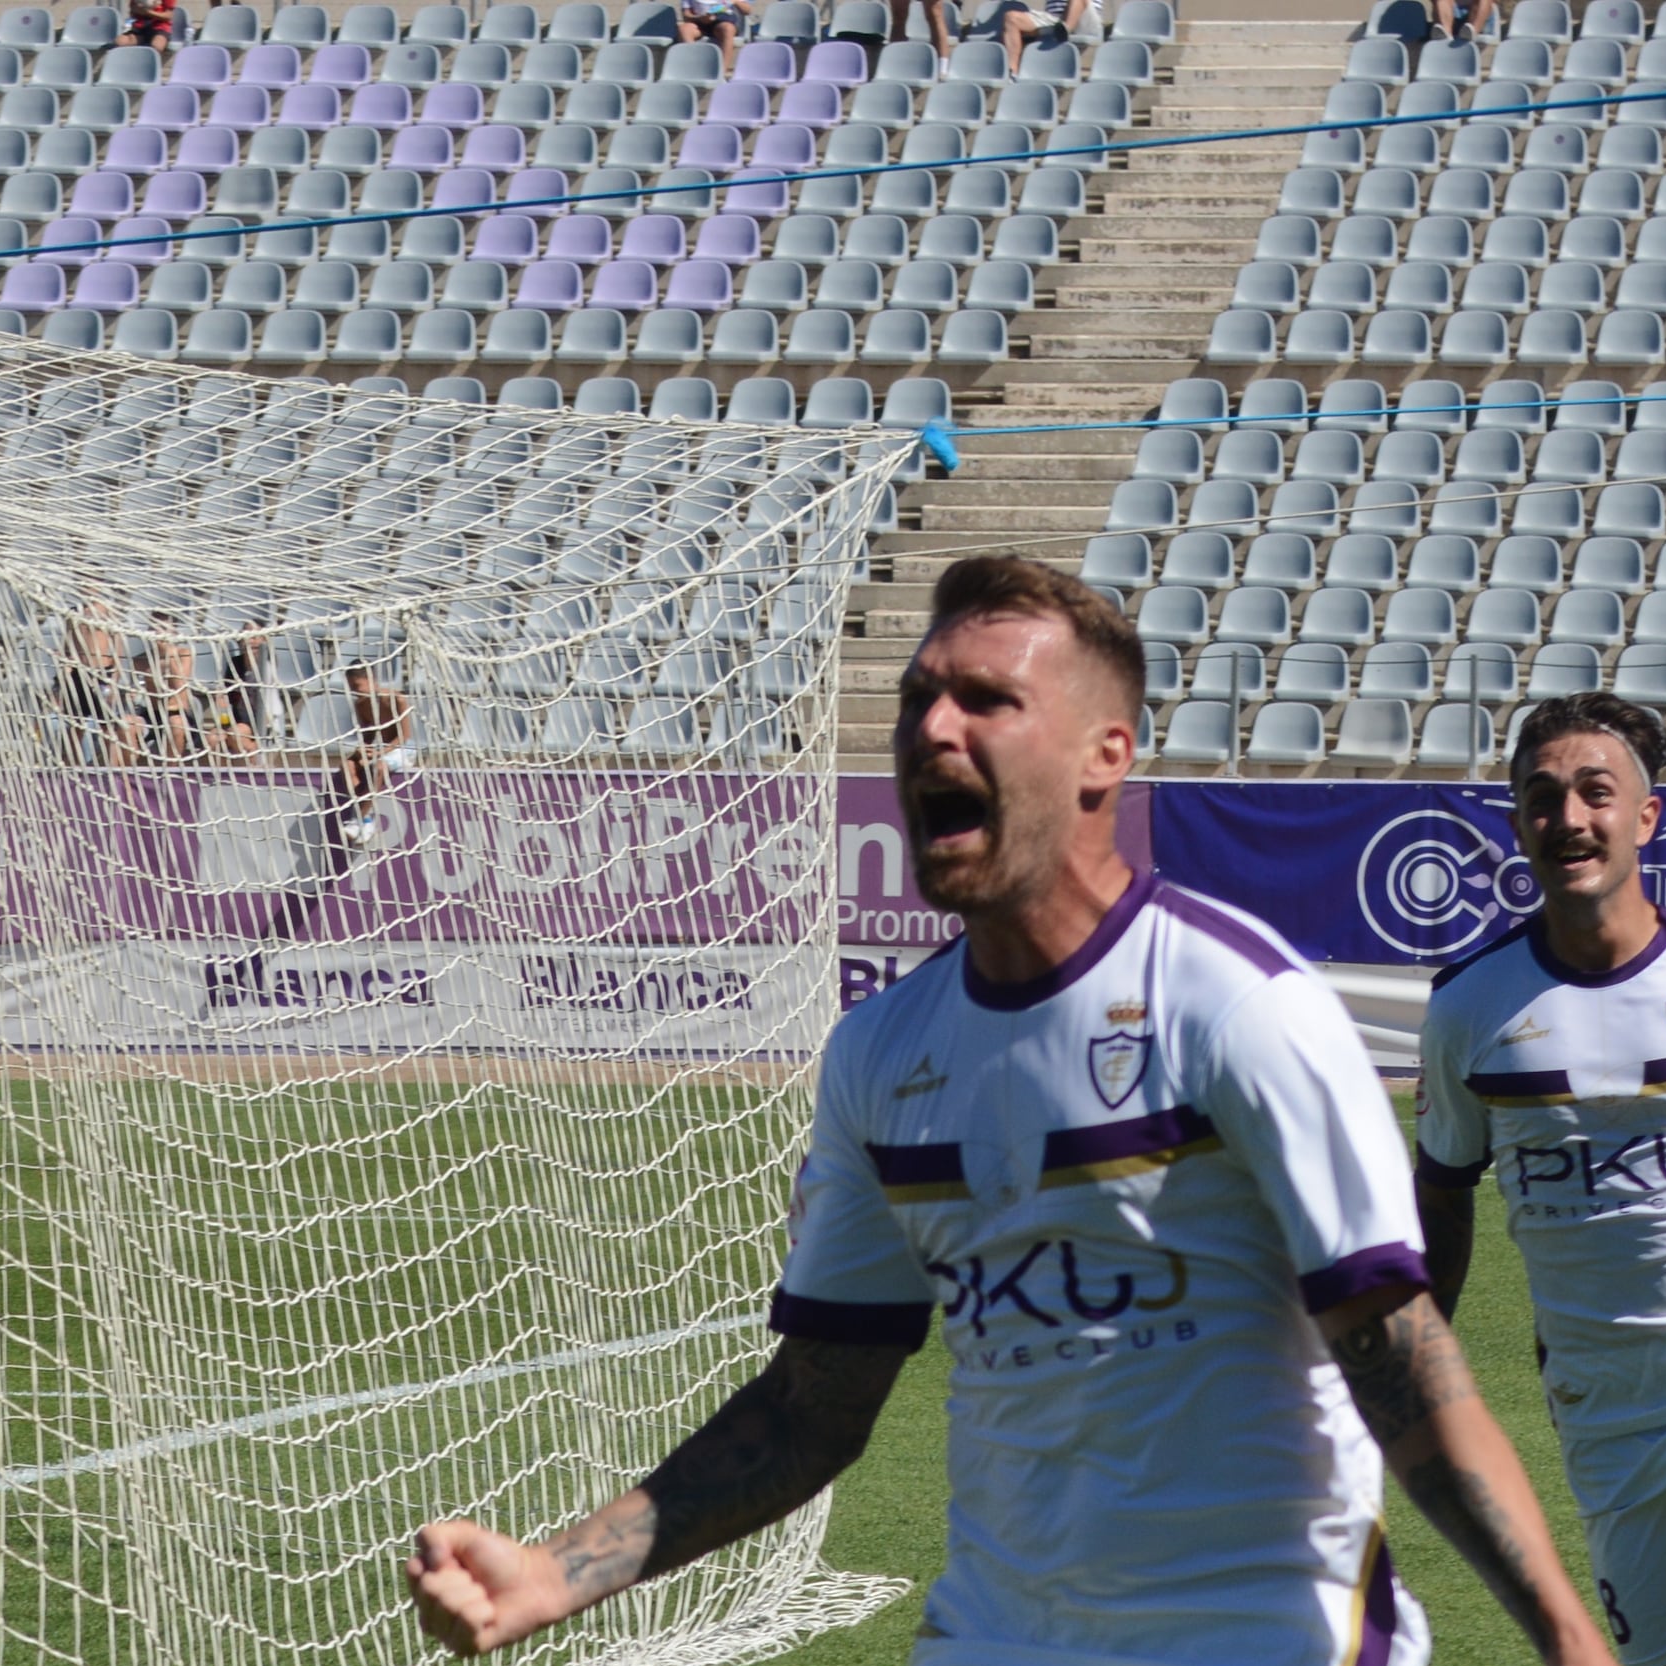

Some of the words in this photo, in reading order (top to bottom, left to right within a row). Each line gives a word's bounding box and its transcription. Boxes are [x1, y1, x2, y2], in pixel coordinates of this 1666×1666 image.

[205, 953, 433, 1007] Blanca
[520, 951, 752, 1009] Blanca
[1055, 1319, 1199, 1361] CLUB
